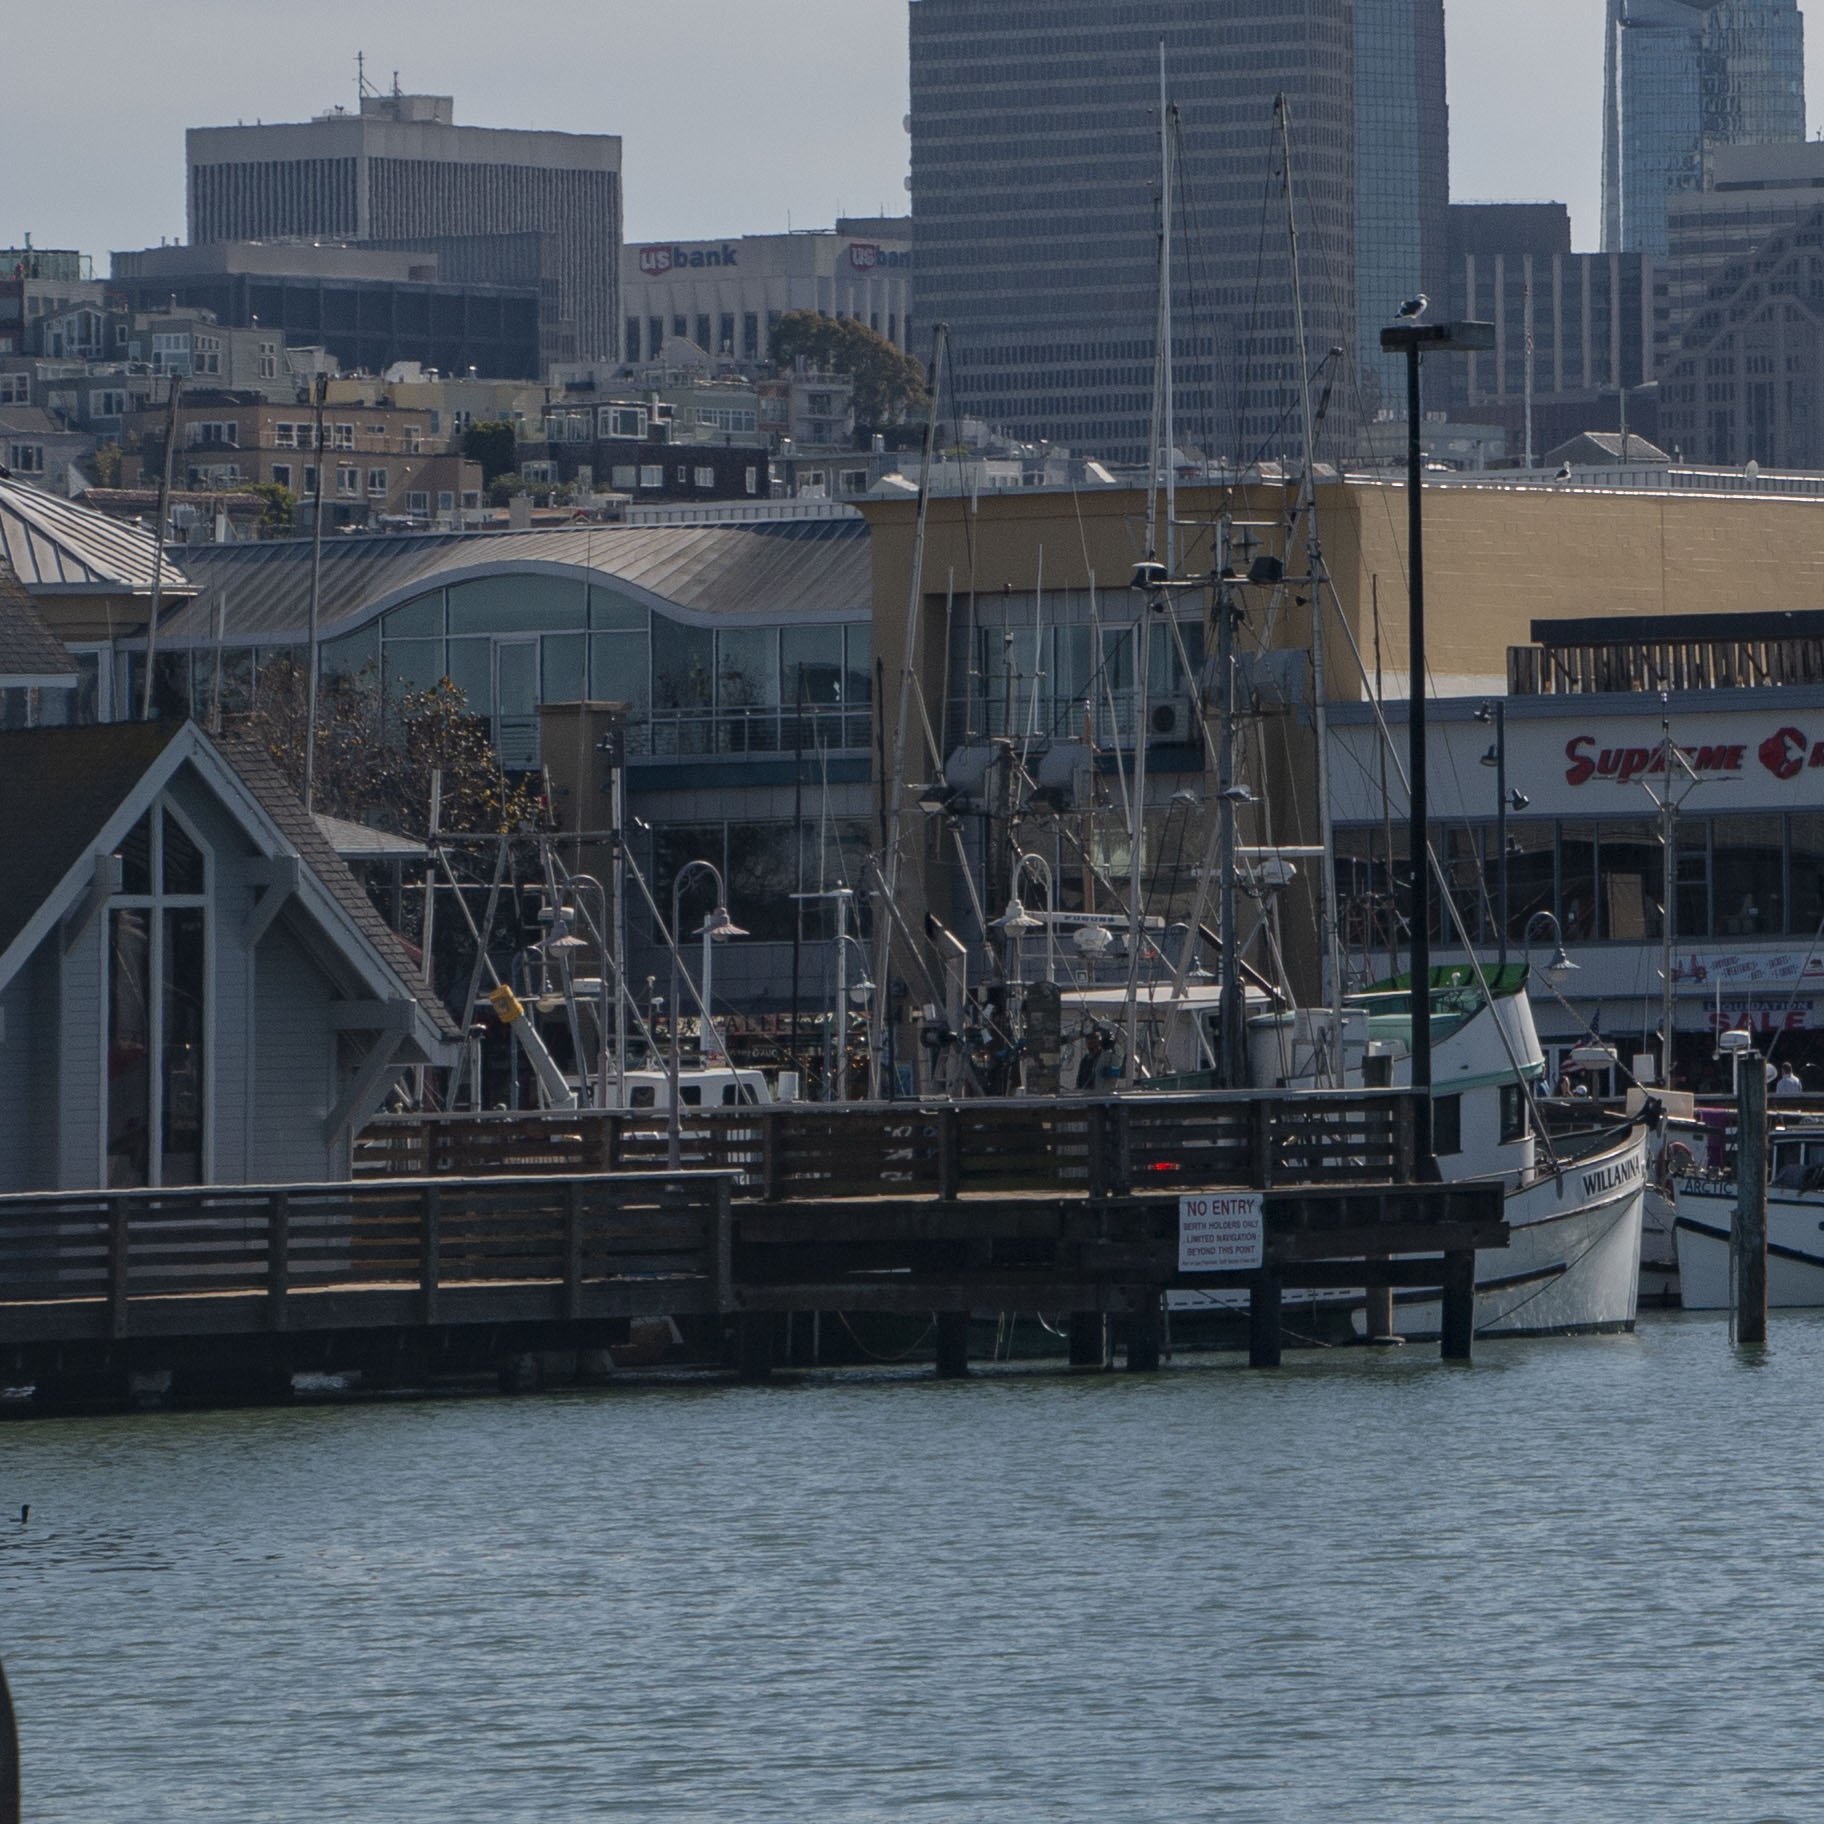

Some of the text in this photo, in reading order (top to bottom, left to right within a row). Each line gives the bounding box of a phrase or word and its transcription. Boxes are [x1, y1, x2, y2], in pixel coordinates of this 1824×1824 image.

[1708, 1011, 1807, 1033] SALE
[1685, 1180, 1733, 1195] ARCTIC
[1187, 1199, 1255, 1217] NO ENTRY
